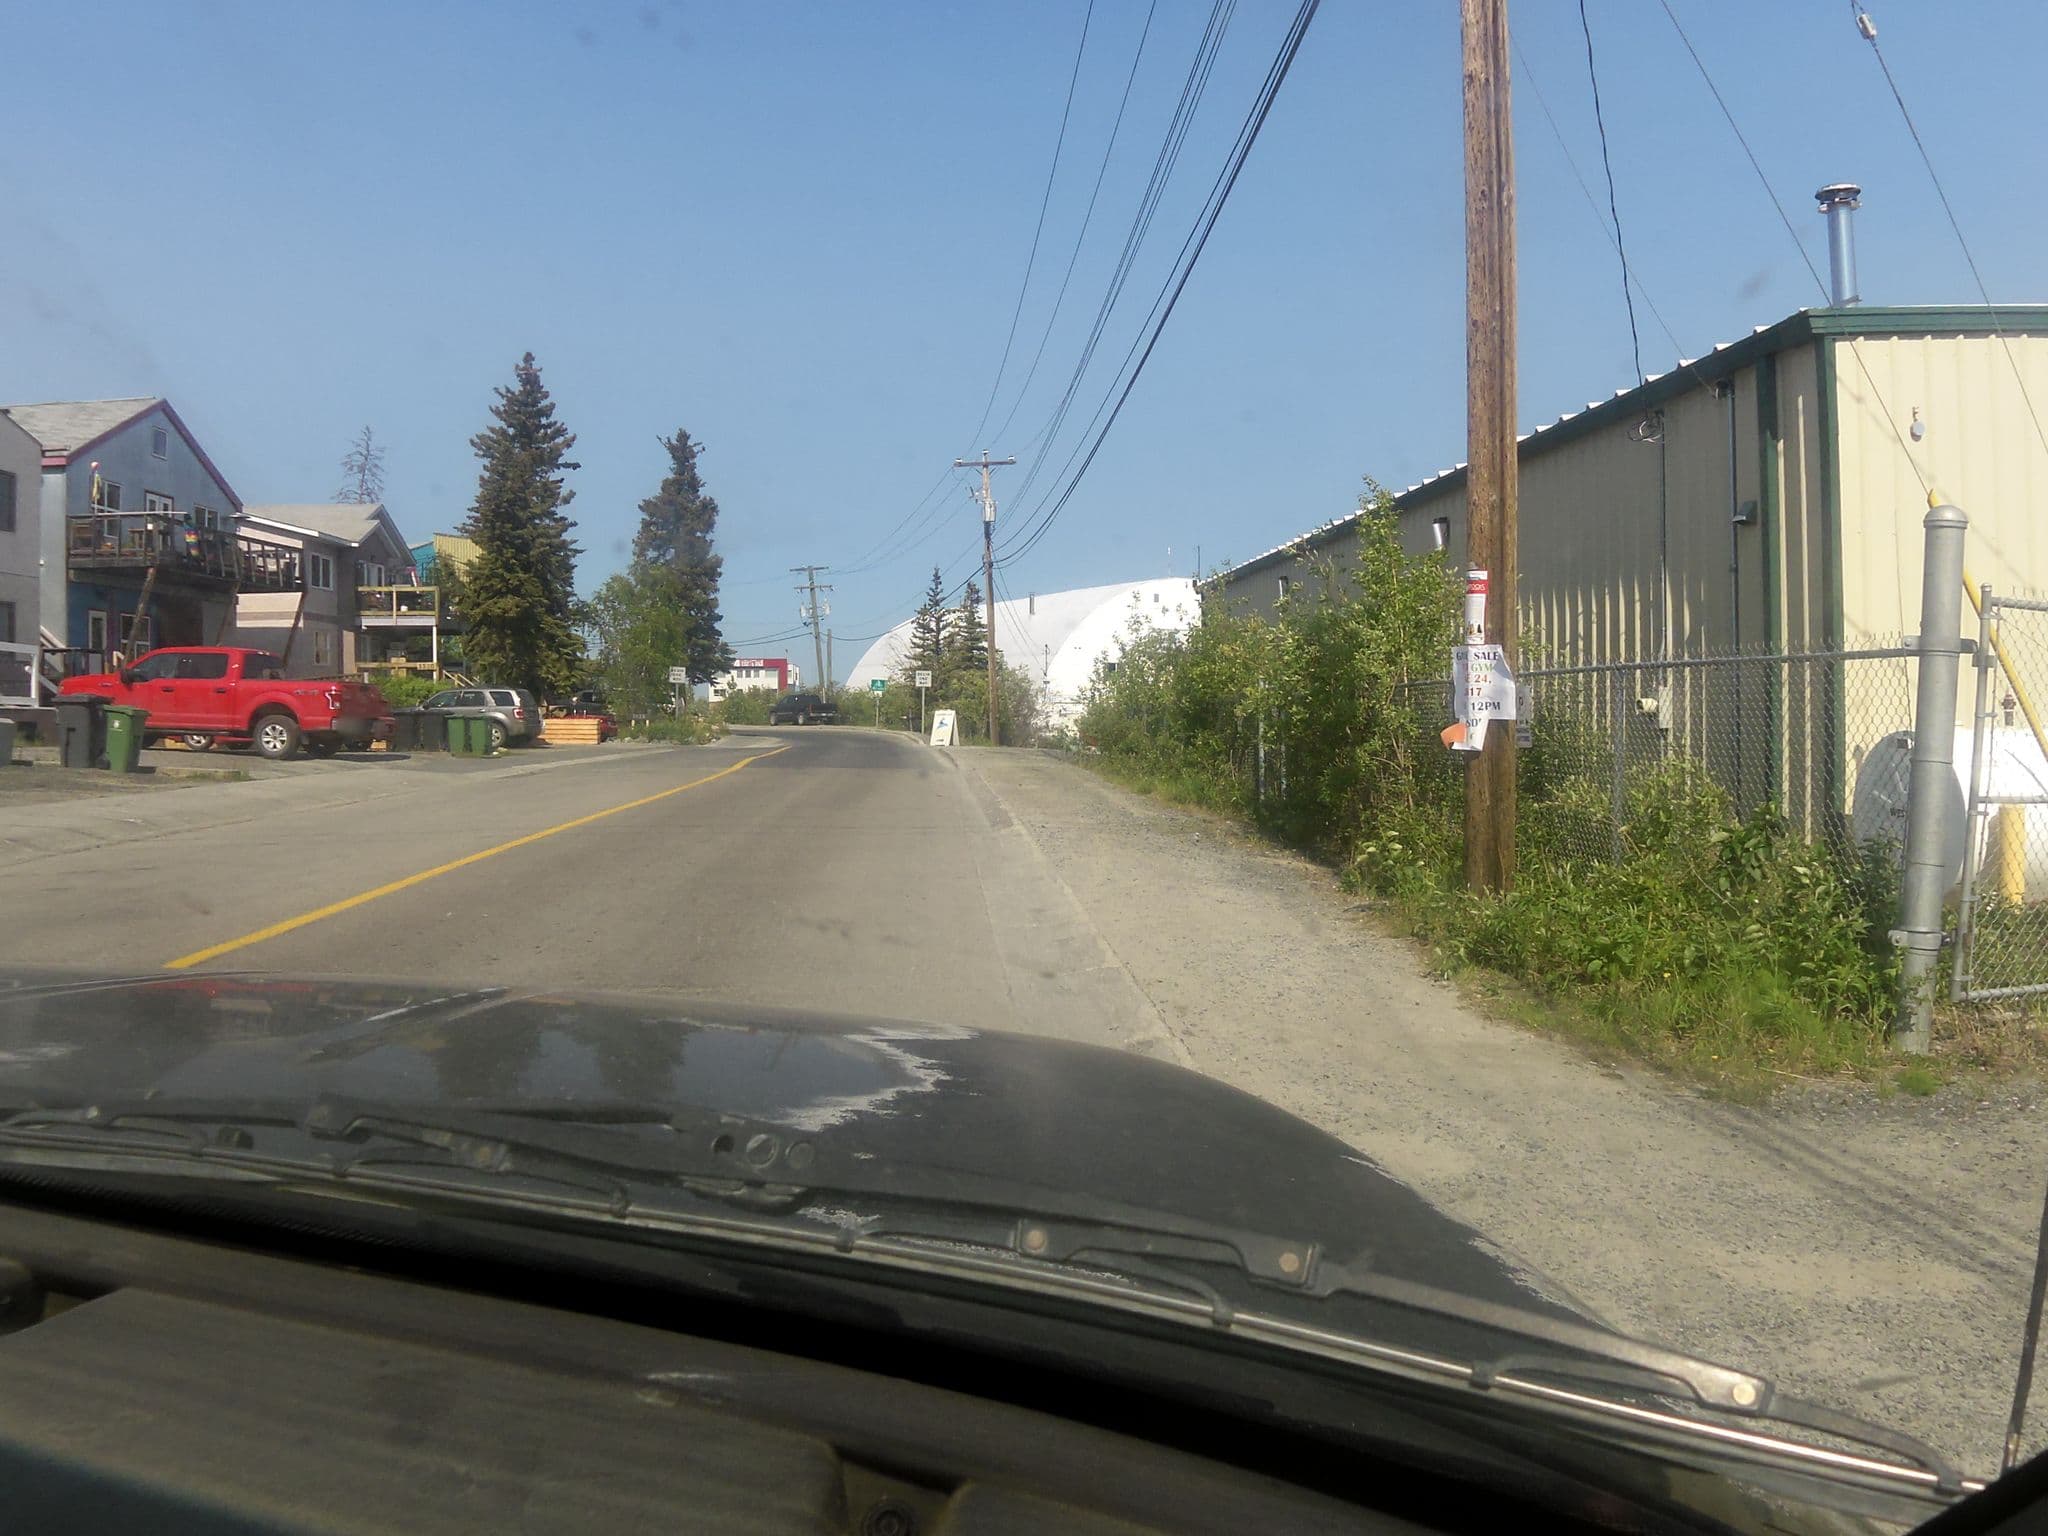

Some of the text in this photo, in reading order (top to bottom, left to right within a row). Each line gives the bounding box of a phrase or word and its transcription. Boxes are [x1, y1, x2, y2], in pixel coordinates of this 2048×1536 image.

[1474, 651, 1499, 661] SALE
[1471, 663, 1493, 672] GYM
[1471, 702, 1501, 711] 12PM
